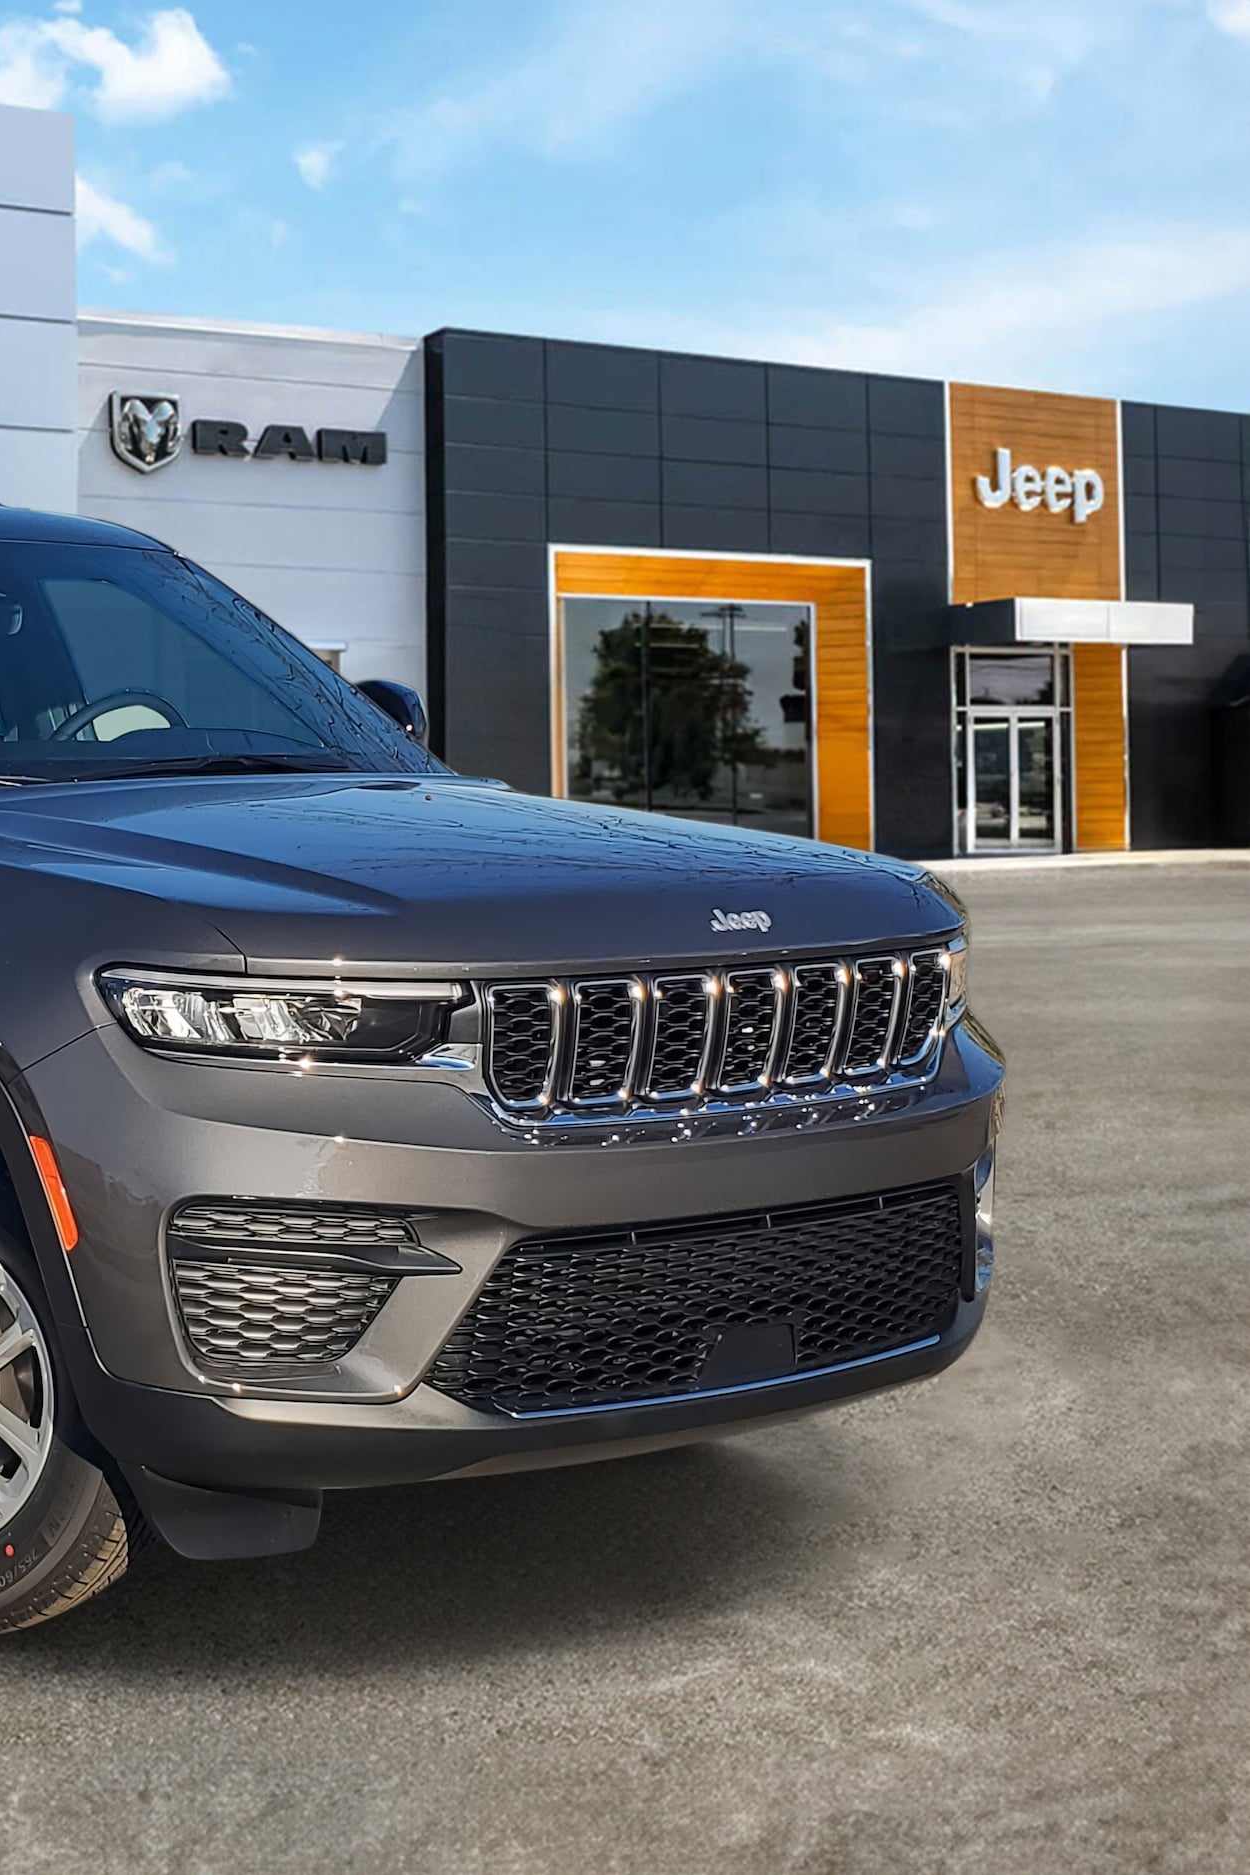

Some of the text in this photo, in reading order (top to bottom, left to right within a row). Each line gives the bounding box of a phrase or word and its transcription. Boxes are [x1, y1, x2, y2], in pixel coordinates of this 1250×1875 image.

[191, 418, 388, 465] RAM
[975, 447, 1104, 523] Jeep
[710, 908, 772, 933] Jeep
